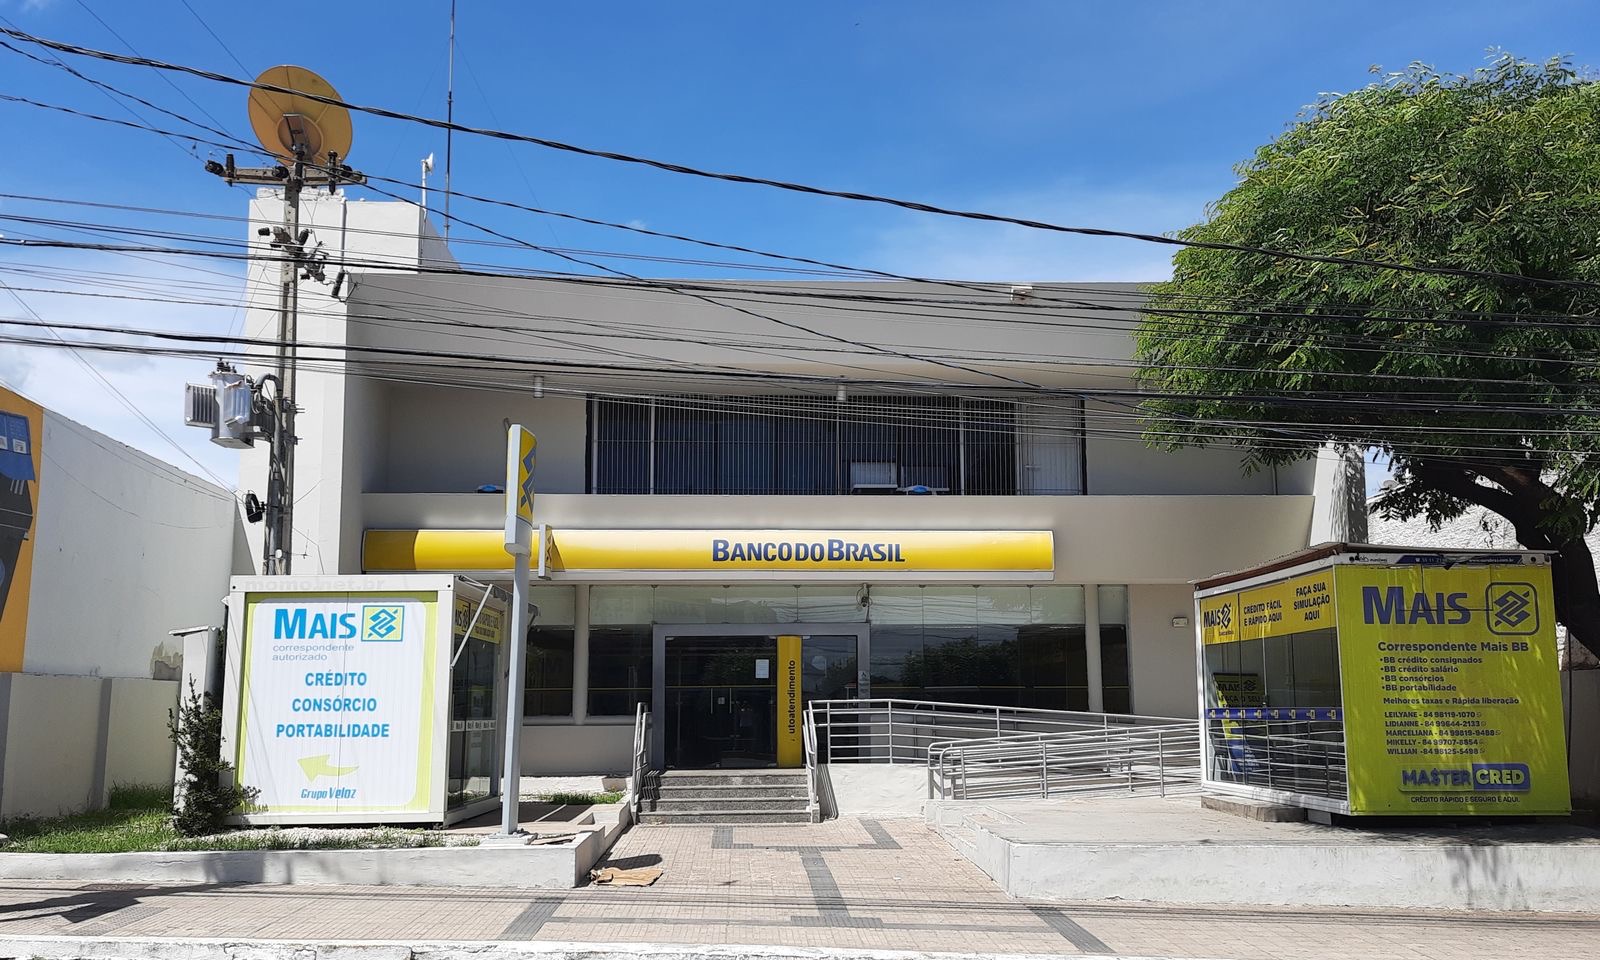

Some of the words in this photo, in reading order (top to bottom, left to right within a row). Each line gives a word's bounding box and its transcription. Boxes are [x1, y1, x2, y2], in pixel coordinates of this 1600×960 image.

[712, 539, 792, 562] BANCO
[794, 543, 825, 562] DO
[827, 539, 905, 562] BRASIL
[1295, 585, 1312, 598] FAÇA
[1312, 582, 1326, 593] SUA
[1293, 594, 1330, 611] SIMULAÇÃO
[1362, 586, 1471, 625] MAIS
[1203, 609, 1221, 628] MAIS
[1243, 618, 1248, 627] E
[1267, 611, 1283, 623] AQUI
[1304, 609, 1320, 623] AQUI
[273, 608, 357, 640] MAIS
[272, 644, 355, 655] correspondente
[1377, 641, 1478, 653] Correspondente
[1480, 641, 1509, 652] Mais
[1511, 642, 1529, 652] BB
[272, 653, 328, 661] autorizado
[1397, 656, 1428, 664] crédito
[1430, 656, 1483, 666] consignados
[1398, 665, 1428, 673] crédito
[1430, 665, 1459, 673] salário
[304, 669, 368, 687] CRÉDITO
[1399, 674, 1445, 682] consórcios
[1399, 683, 1457, 693] portabilidade
[291, 695, 378, 712] CONSÓRCIO
[788, 659, 797, 736] utoatendimento
[1452, 696, 1480, 706] Rápida
[1481, 696, 1520, 706] liberação
[275, 723, 391, 738] PORTABILIDADE
[300, 788, 328, 801] Grupo
[328, 786, 357, 800] Veloz
[1410, 795, 1439, 803] CRÉDITO
